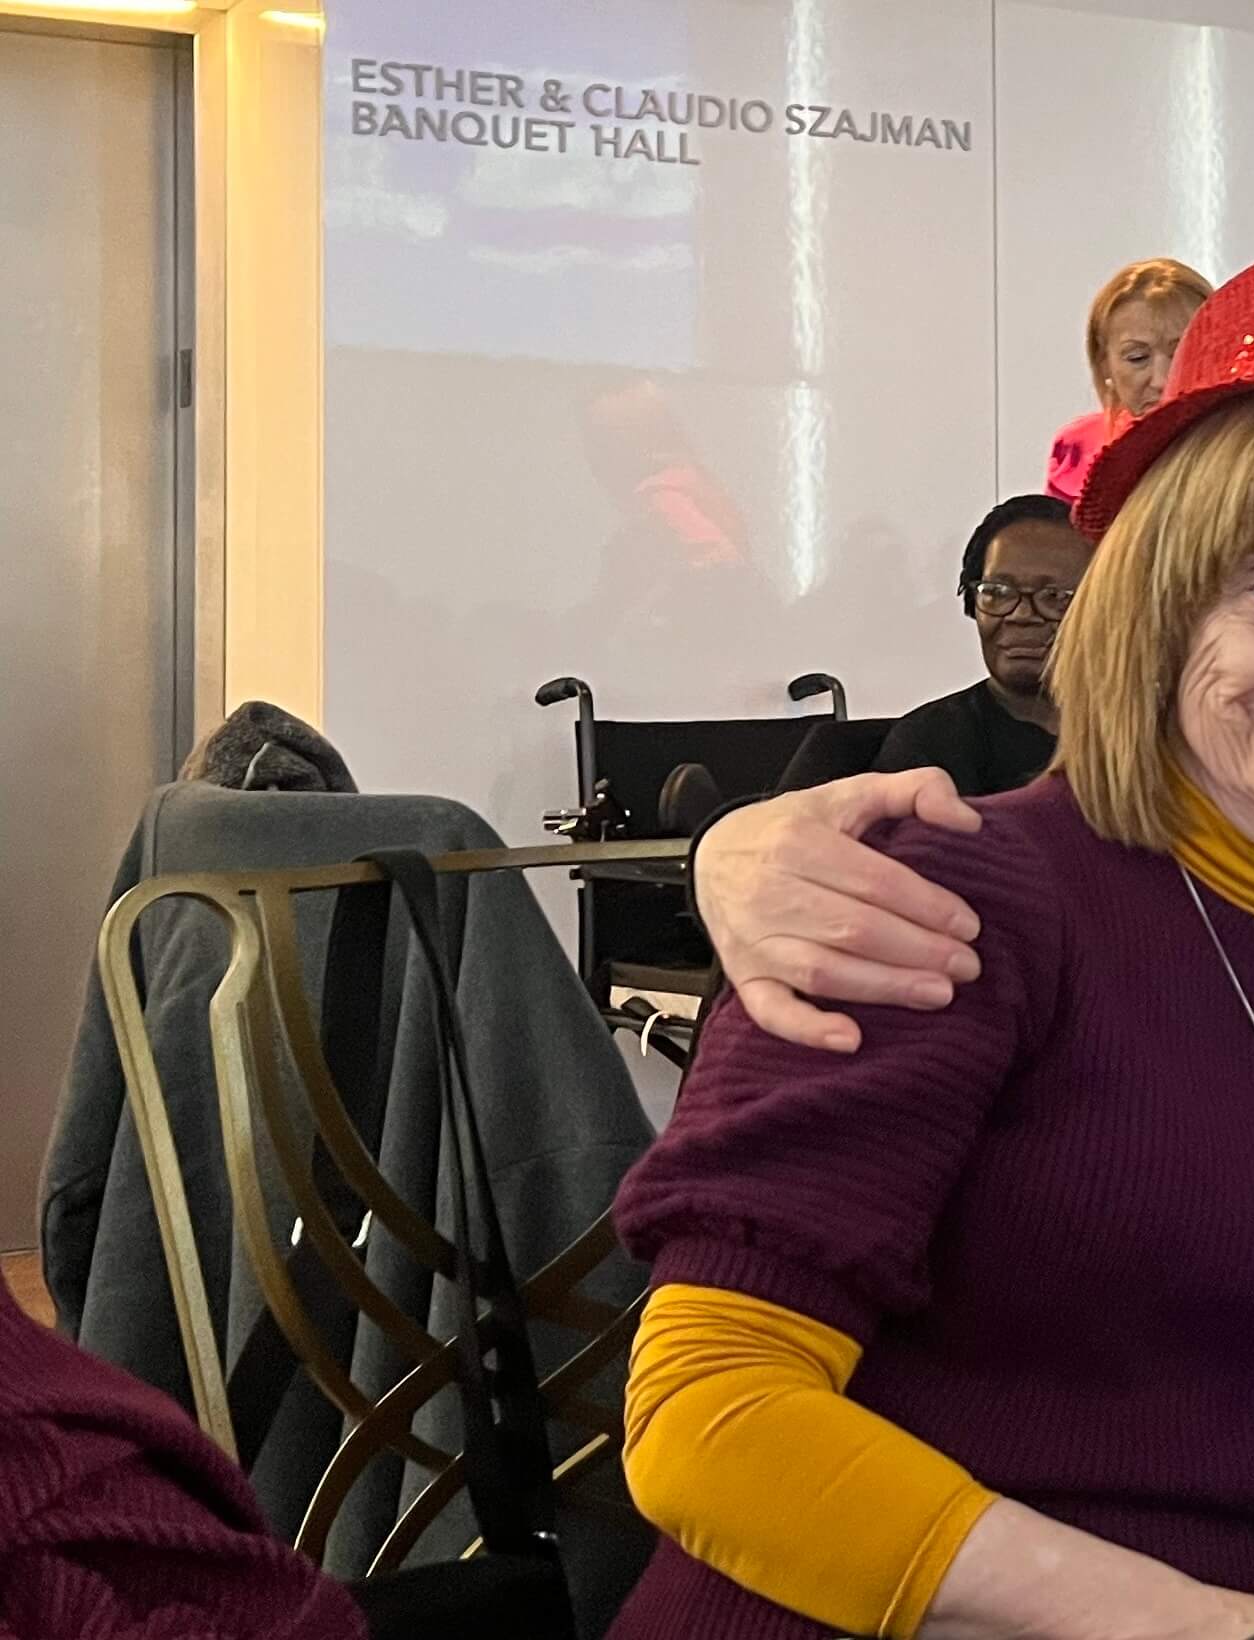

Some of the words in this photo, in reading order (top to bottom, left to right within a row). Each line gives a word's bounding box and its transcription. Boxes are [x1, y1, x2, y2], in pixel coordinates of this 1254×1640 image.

[351, 58, 525, 108] ESTHER
[539, 78, 573, 113] &
[582, 82, 774, 134] CLAUDIO
[784, 103, 972, 152] SZAJMAN
[351, 100, 576, 153] BANQUET
[590, 123, 700, 165] HALL
